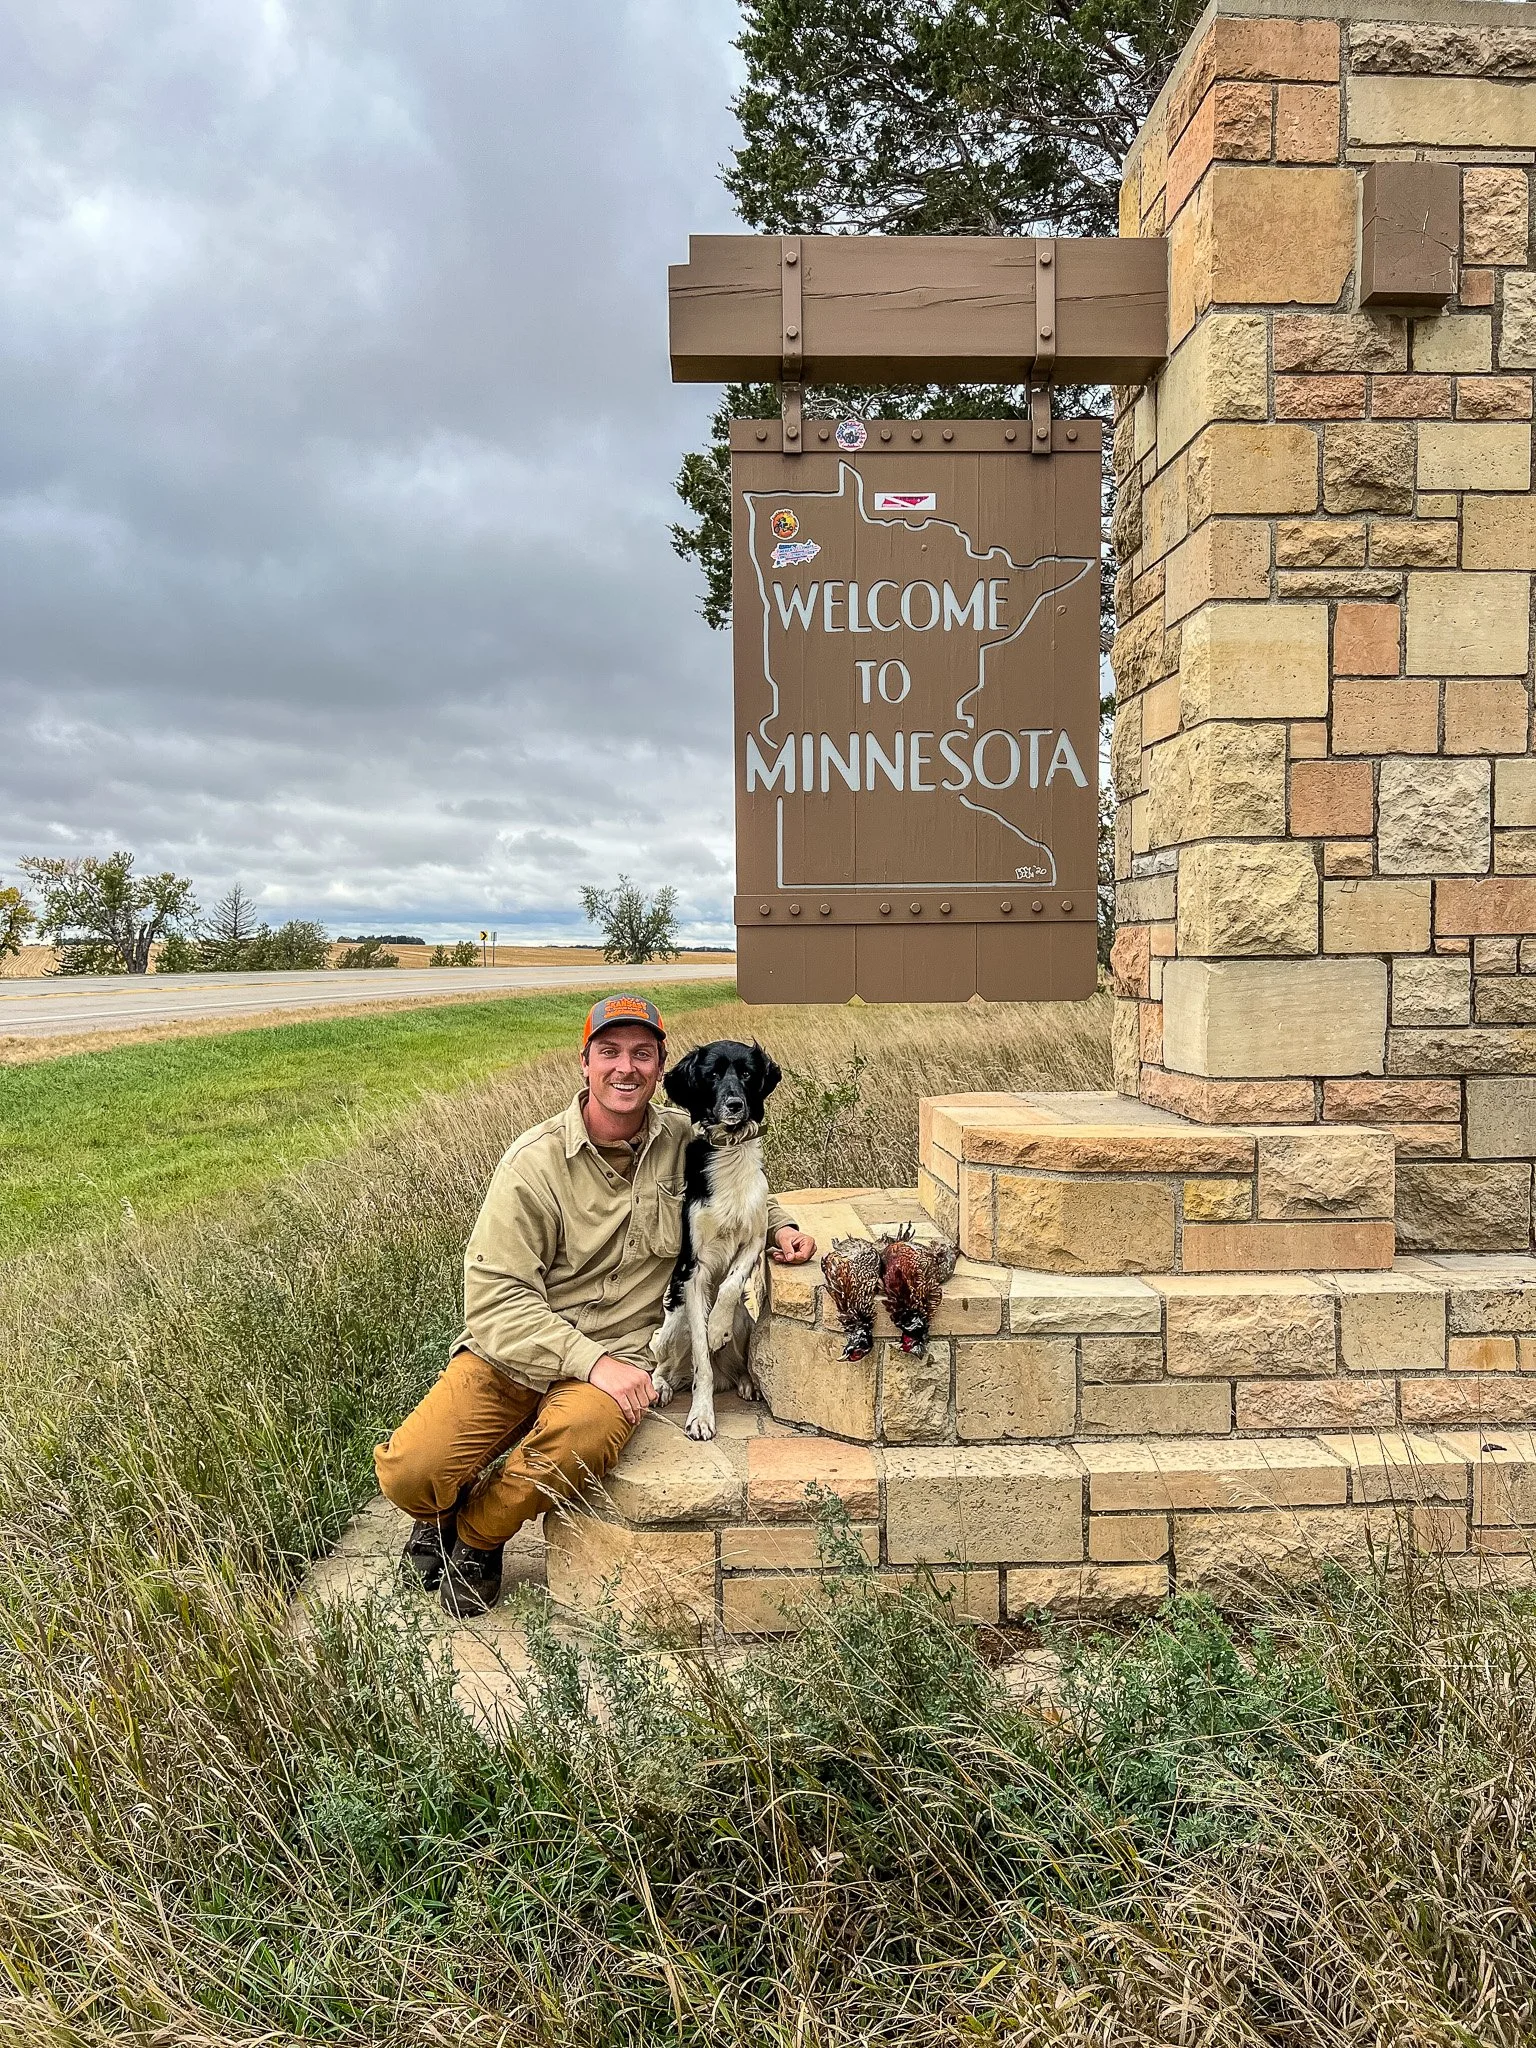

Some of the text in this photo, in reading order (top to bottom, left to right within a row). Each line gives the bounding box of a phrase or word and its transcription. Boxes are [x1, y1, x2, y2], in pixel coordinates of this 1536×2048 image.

[772, 579, 1010, 633] WELCOME
[854, 659, 911, 704] TO
[745, 729, 1089, 794] MINNESOTA
